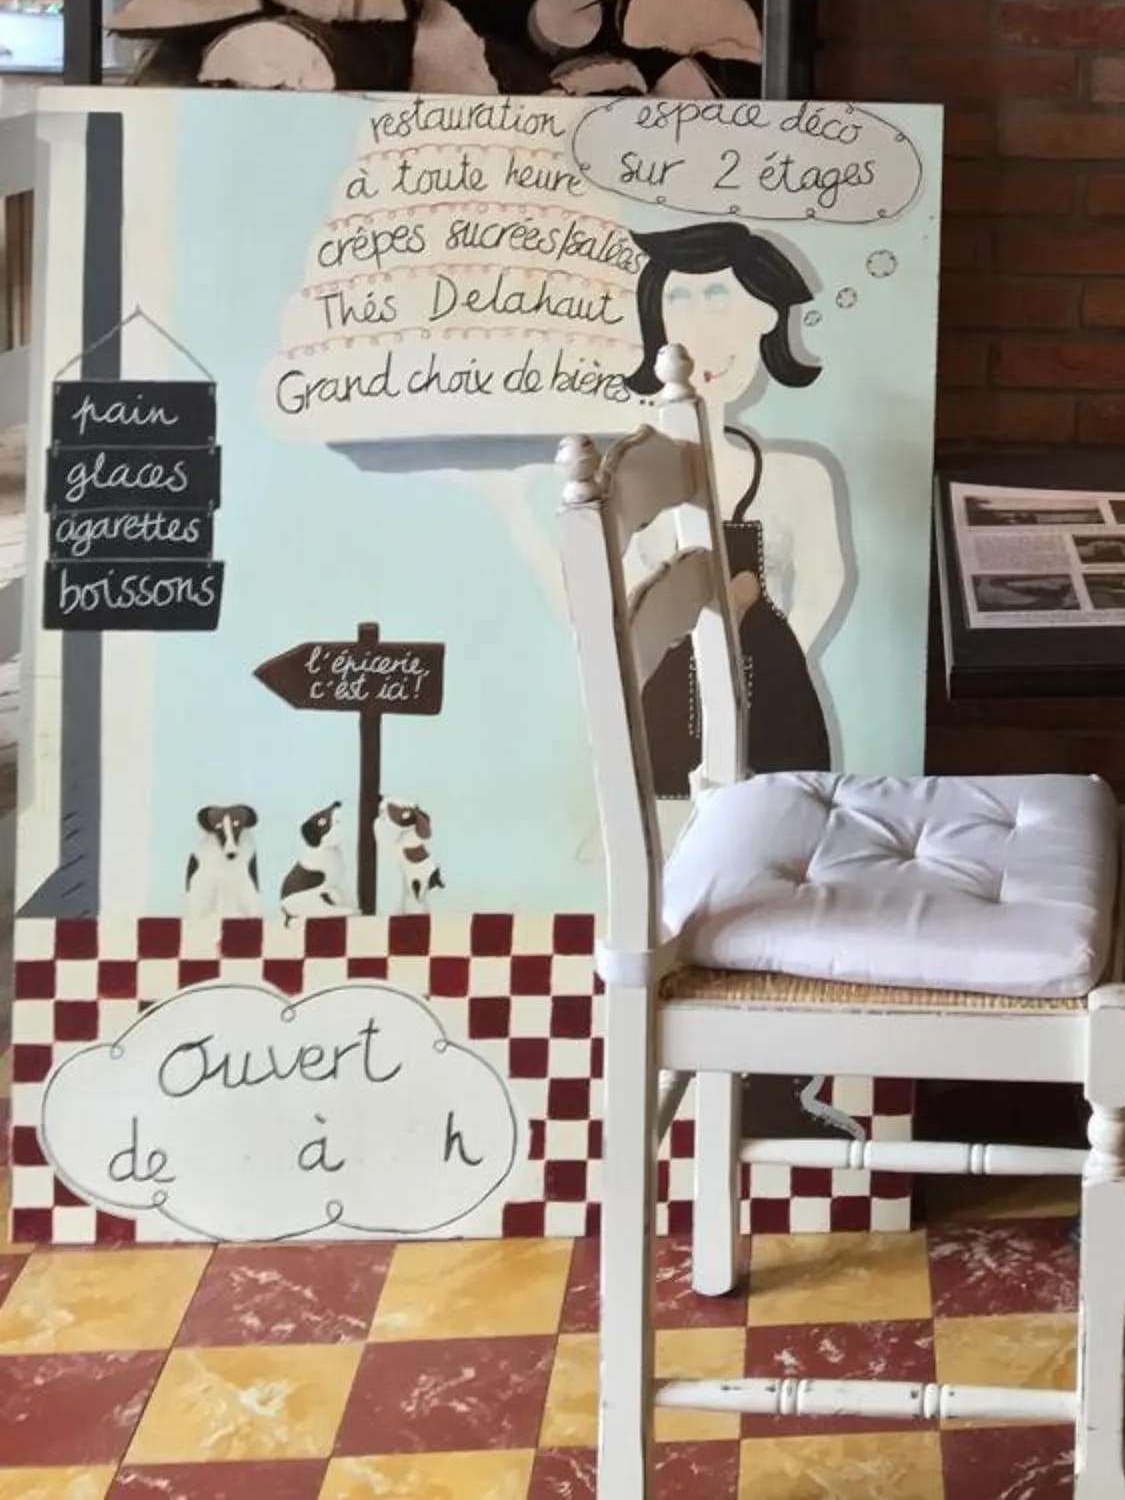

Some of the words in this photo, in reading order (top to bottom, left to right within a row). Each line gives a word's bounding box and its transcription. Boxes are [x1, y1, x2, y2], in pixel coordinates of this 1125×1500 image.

[371, 96, 567, 143] restauration
[635, 99, 772, 144] espace
[779, 100, 864, 145] déco
[345, 167, 379, 200] à
[391, 152, 489, 195] toute
[504, 155, 586, 197] heure
[620, 150, 687, 187] sur
[712, 148, 742, 189] 2
[758, 150, 877, 209] étages
[317, 222, 426, 270] crêpes
[314, 291, 398, 330] Thés
[428, 272, 625, 325] Delahaut
[275, 350, 401, 416] Grand
[407, 352, 495, 395] choix
[502, 348, 544, 394] de
[70, 393, 180, 436] pain
[65, 451, 189, 503] glaces
[59, 567, 216, 615] boissons
[308, 673, 370, 701] c'est
[158, 1017, 402, 1098] Ouvert
[107, 1116, 177, 1183] de
[297, 1113, 346, 1172] à
[443, 1110, 484, 1167] h
